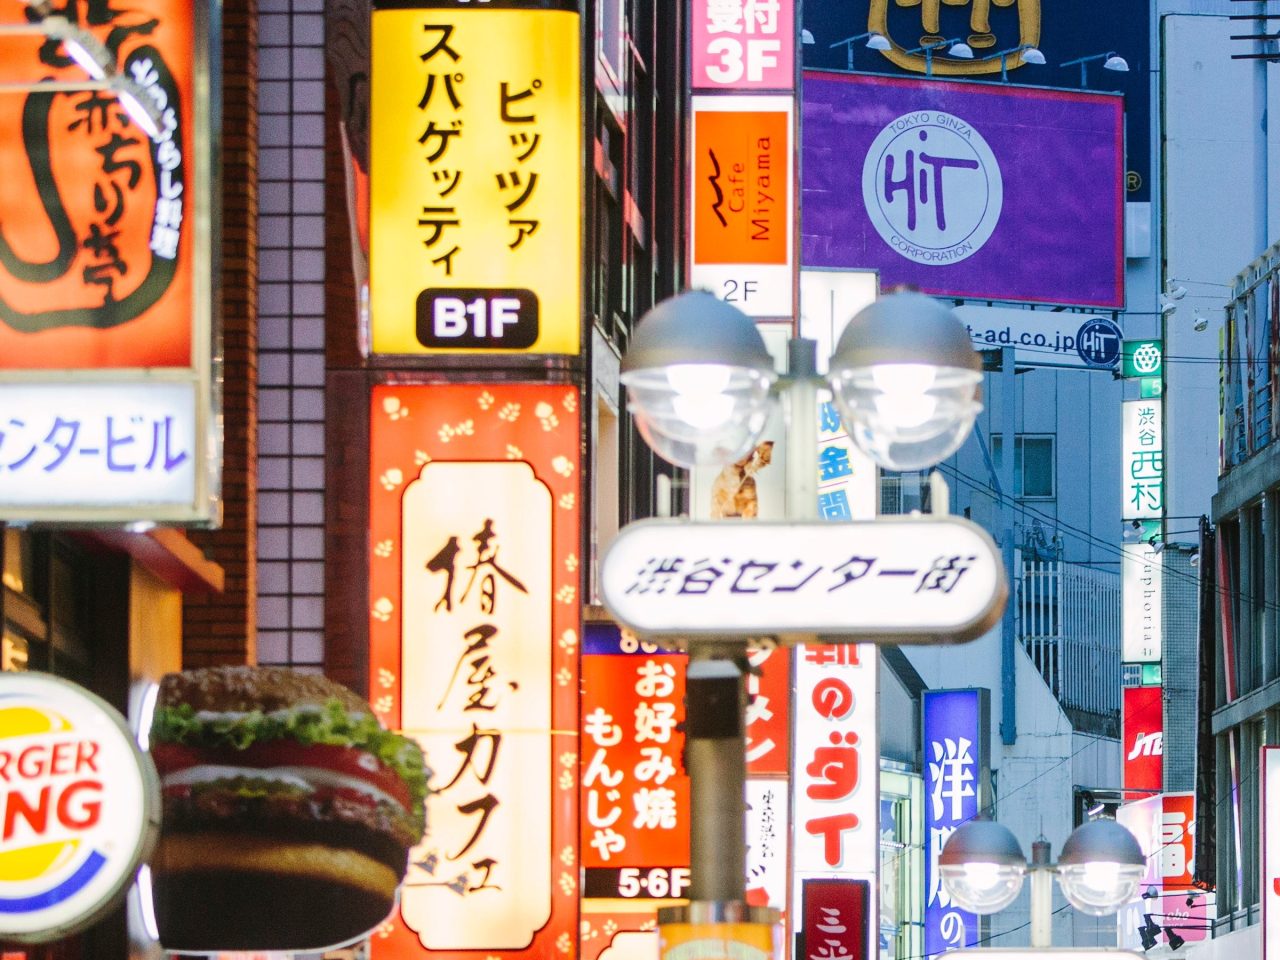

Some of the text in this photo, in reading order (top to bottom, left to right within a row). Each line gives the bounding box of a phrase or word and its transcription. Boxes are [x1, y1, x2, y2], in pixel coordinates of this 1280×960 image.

[706, 0, 780, 35] 受付
[705, 38, 781, 83] 3F
[417, 23, 465, 276] スパゲッティ
[889, 113, 972, 139] TOKYO GINZA
[495, 78, 543, 250] ピッツァ
[729, 162, 745, 213] Cafe
[752, 137, 775, 241] Miyama
[890, 235, 972, 262] CORPORATION
[724, 280, 758, 302] 2F
[432, 298, 521, 338] B1F
[1131, 407, 1162, 511] 渋谷西村
[625, 553, 979, 597] 渋谷センター街
[421, 518, 530, 895] 椿屋カフェ
[633, 660, 677, 829] お好み焼
[584, 707, 626, 861] もんじゃ
